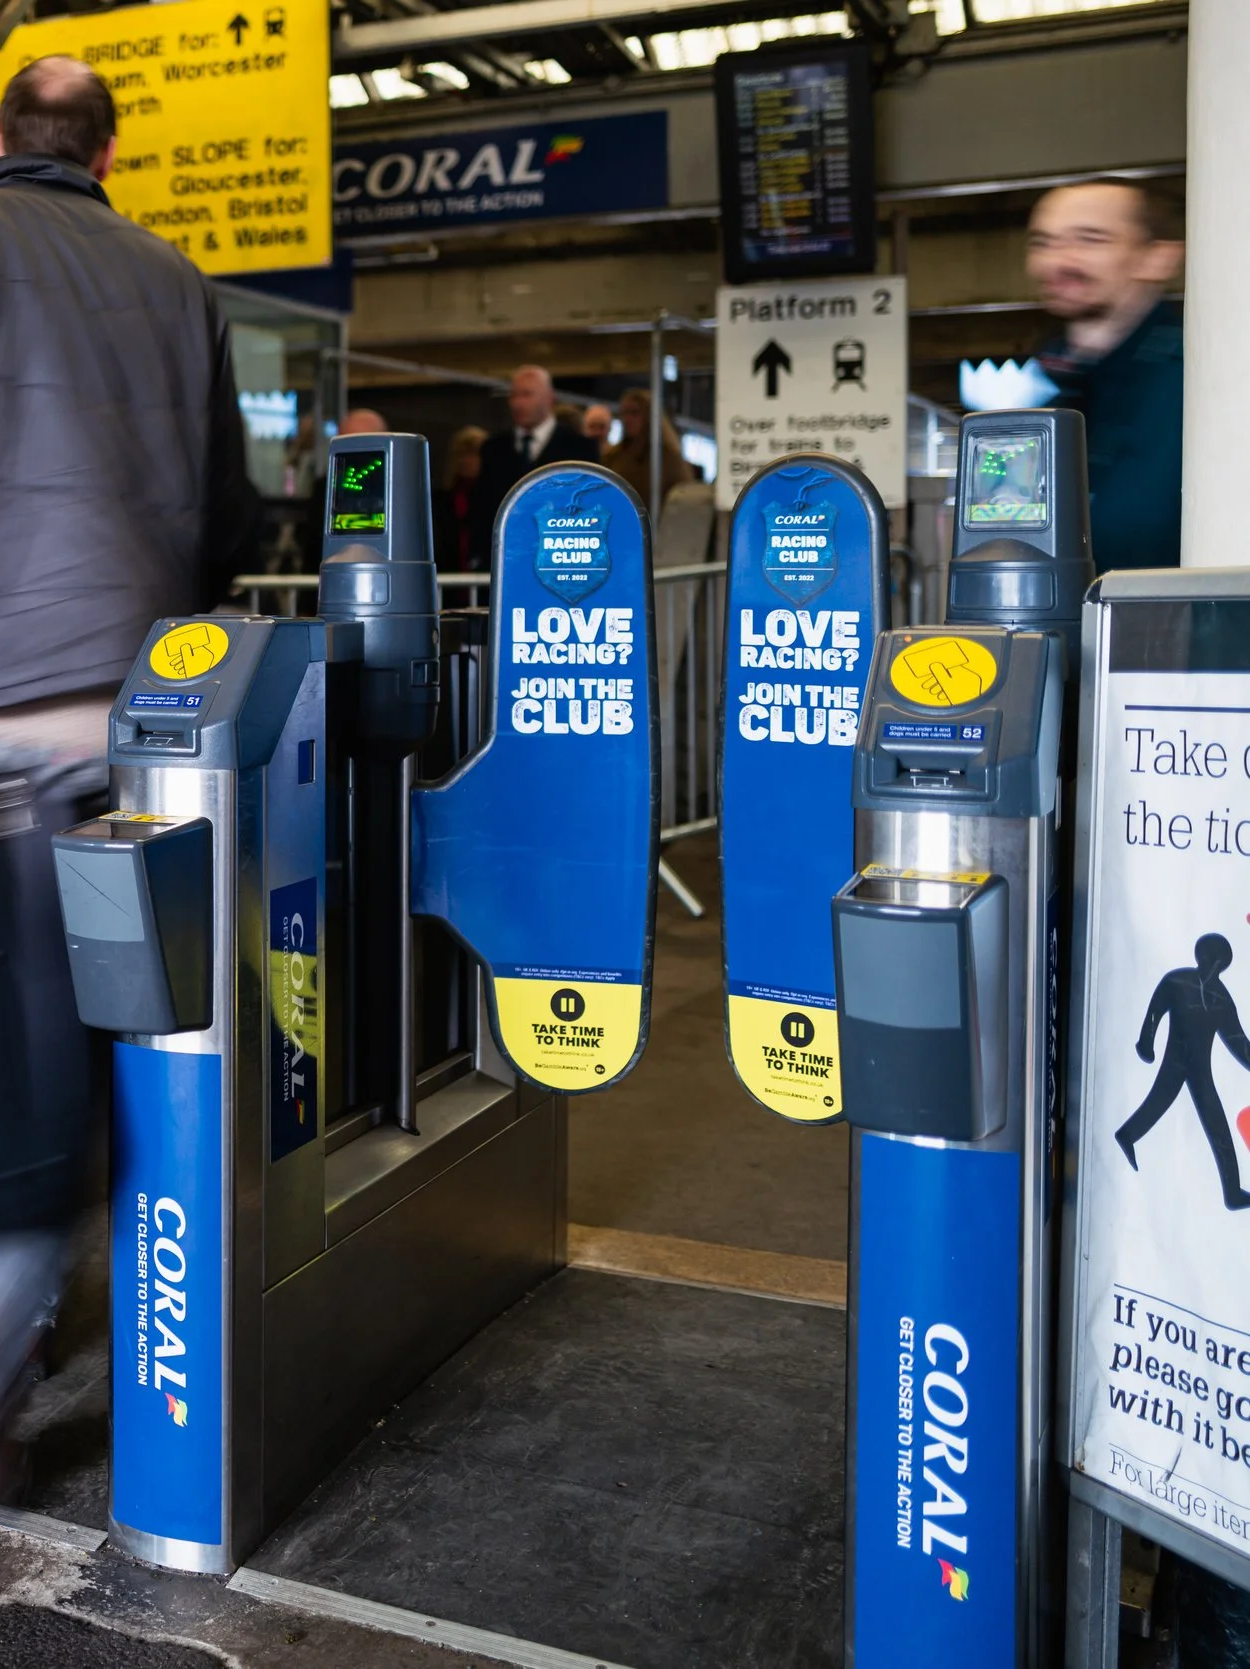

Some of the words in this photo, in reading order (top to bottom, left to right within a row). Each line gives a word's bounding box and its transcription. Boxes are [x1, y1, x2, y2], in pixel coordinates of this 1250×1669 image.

[82, 35, 164, 64] BRIDGE
[162, 52, 287, 82] Worcester
[115, 95, 162, 118] orth
[113, 153, 160, 173] own
[171, 139, 250, 167] SLOPE
[333, 138, 546, 202] CORAL
[228, 193, 309, 220] Bristol
[204, 230, 219, 251] &
[234, 227, 308, 249] Wales
[730, 294, 856, 323] Platform
[872, 288, 891, 316] 2
[731, 415, 776, 434] Over
[787, 414, 890, 432] footbridge
[730, 439, 757, 455] for
[769, 438, 824, 451] trains
[834, 437, 855, 451] to
[547, 518, 591, 527] CORAL
[775, 515, 818, 524] CORAL
[544, 537, 600, 550] RACING
[771, 536, 827, 548] RACING
[552, 551, 592, 564] CLUB
[779, 551, 818, 563] CLUB
[512, 608, 634, 643] LOVE
[740, 609, 860, 648] LOVE
[512, 643, 633, 664] RACING?
[740, 646, 860, 672] RACING?
[186, 697, 200, 706] 51
[511, 678, 576, 699] JOIN
[579, 678, 634, 700] THE
[739, 682, 802, 706] JOIN
[805, 684, 859, 709] THE
[511, 699, 634, 735] CLUB
[739, 704, 859, 746] CLUB
[962, 728, 982, 738] 52
[1125, 727, 1227, 778] Take
[1123, 800, 1192, 850] the
[290, 912, 305, 1098] CORAL
[532, 1024, 566, 1034] TAKE
[571, 1026, 604, 1037] TIME
[536, 1035, 554, 1045] TO
[557, 1036, 600, 1048] THINK
[762, 1046, 796, 1061] TAKE
[800, 1052, 833, 1067] TIME
[766, 1058, 784, 1070] TO
[787, 1062, 829, 1078] THINK
[138, 1193, 148, 1221] GET
[138, 1222, 148, 1278] CLOSER
[138, 1281, 148, 1300] TO
[154, 1197, 186, 1390] CORAL
[138, 1302, 148, 1331] THE
[900, 1316, 915, 1352] GET
[1113, 1294, 1138, 1329] If
[1146, 1311, 1198, 1354] you
[1205, 1337, 1250, 1376] are
[138, 1332, 148, 1386] ACTION
[1109, 1343, 1209, 1401] please
[899, 1352, 914, 1420] CLOSER
[898, 1423, 914, 1446] TO
[922, 1323, 970, 1556] CORAL
[1109, 1384, 1184, 1435] with
[1193, 1411, 1214, 1449] it
[1220, 1425, 1250, 1469] be
[898, 1449, 913, 1483] THE
[1109, 1449, 1143, 1488] For
[1148, 1470, 1206, 1517] large
[897, 1484, 912, 1548] ACTION
